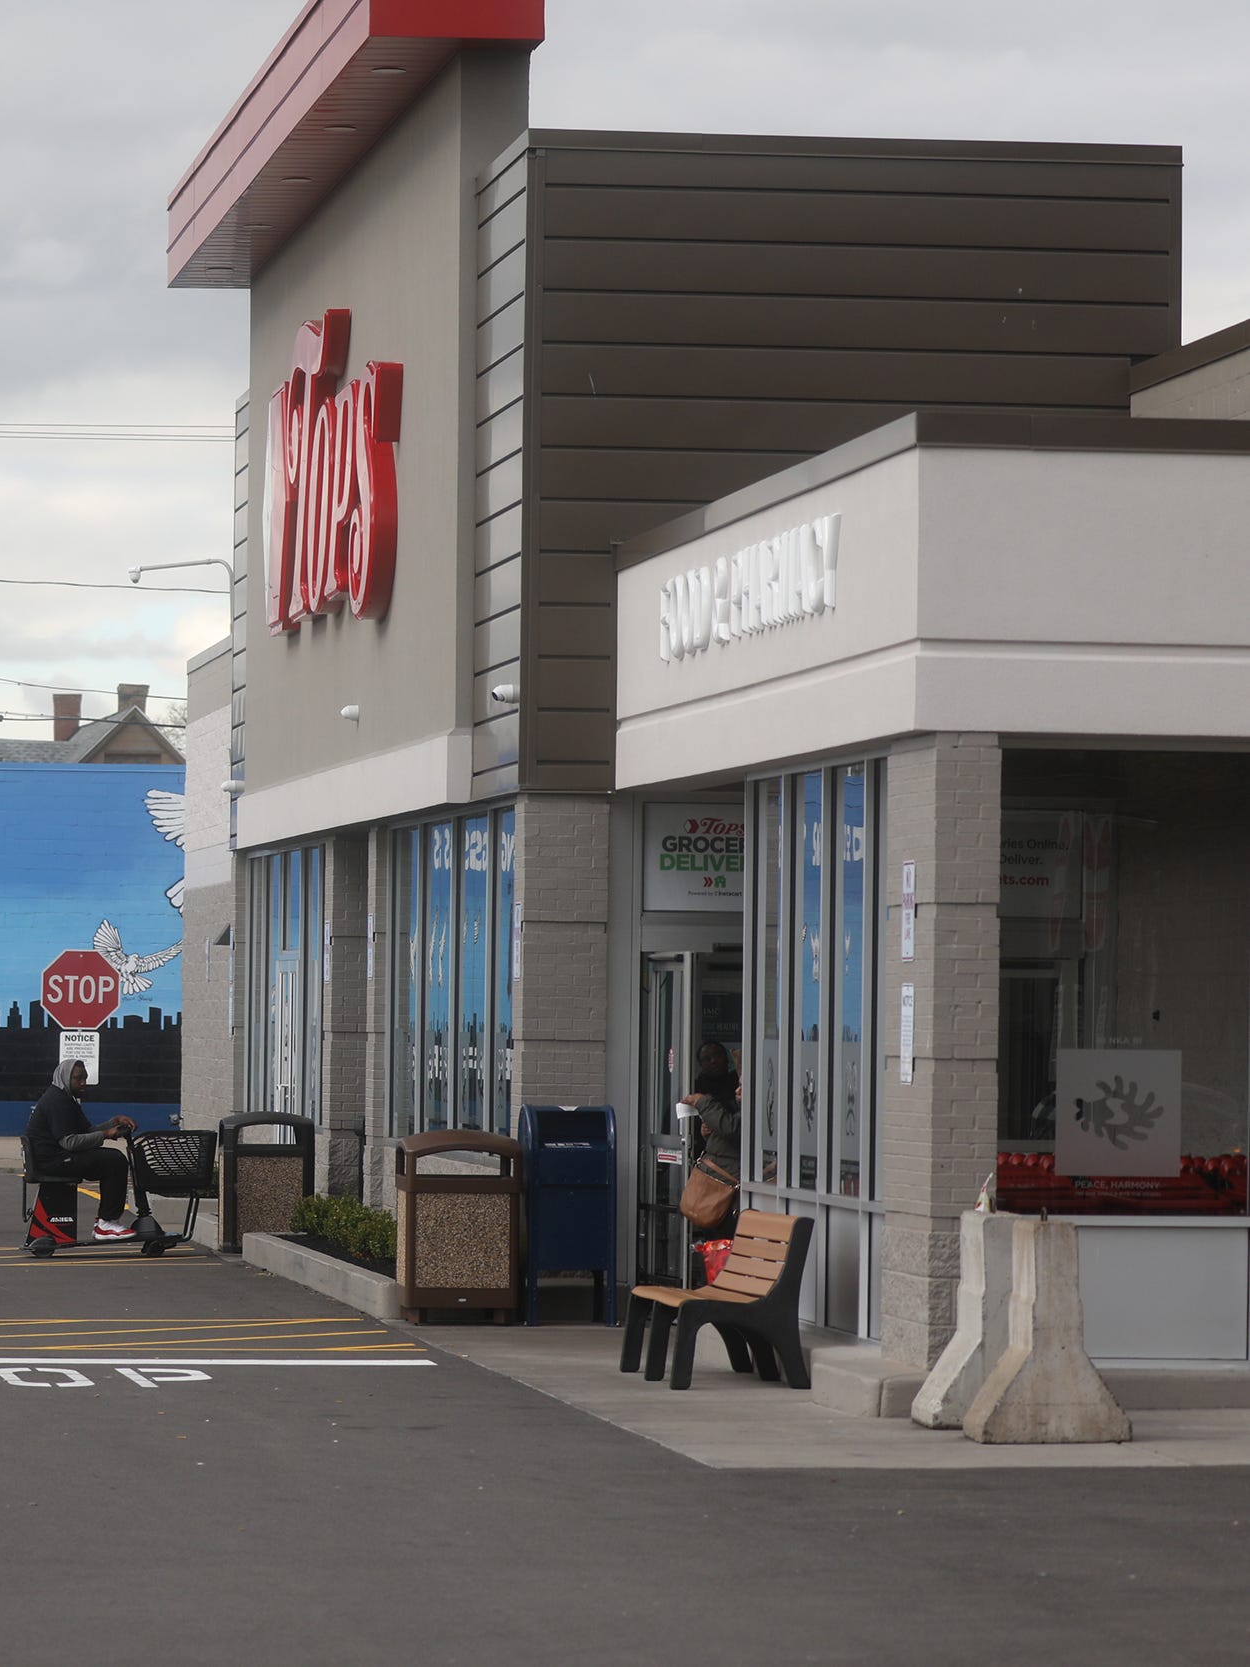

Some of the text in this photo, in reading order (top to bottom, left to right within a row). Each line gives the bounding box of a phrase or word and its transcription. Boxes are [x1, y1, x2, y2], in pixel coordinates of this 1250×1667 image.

[47, 975, 115, 1004] STOP
[64, 1034, 95, 1042] NOTICE
[1074, 1180, 1161, 1190] PEACE, HARMONY
